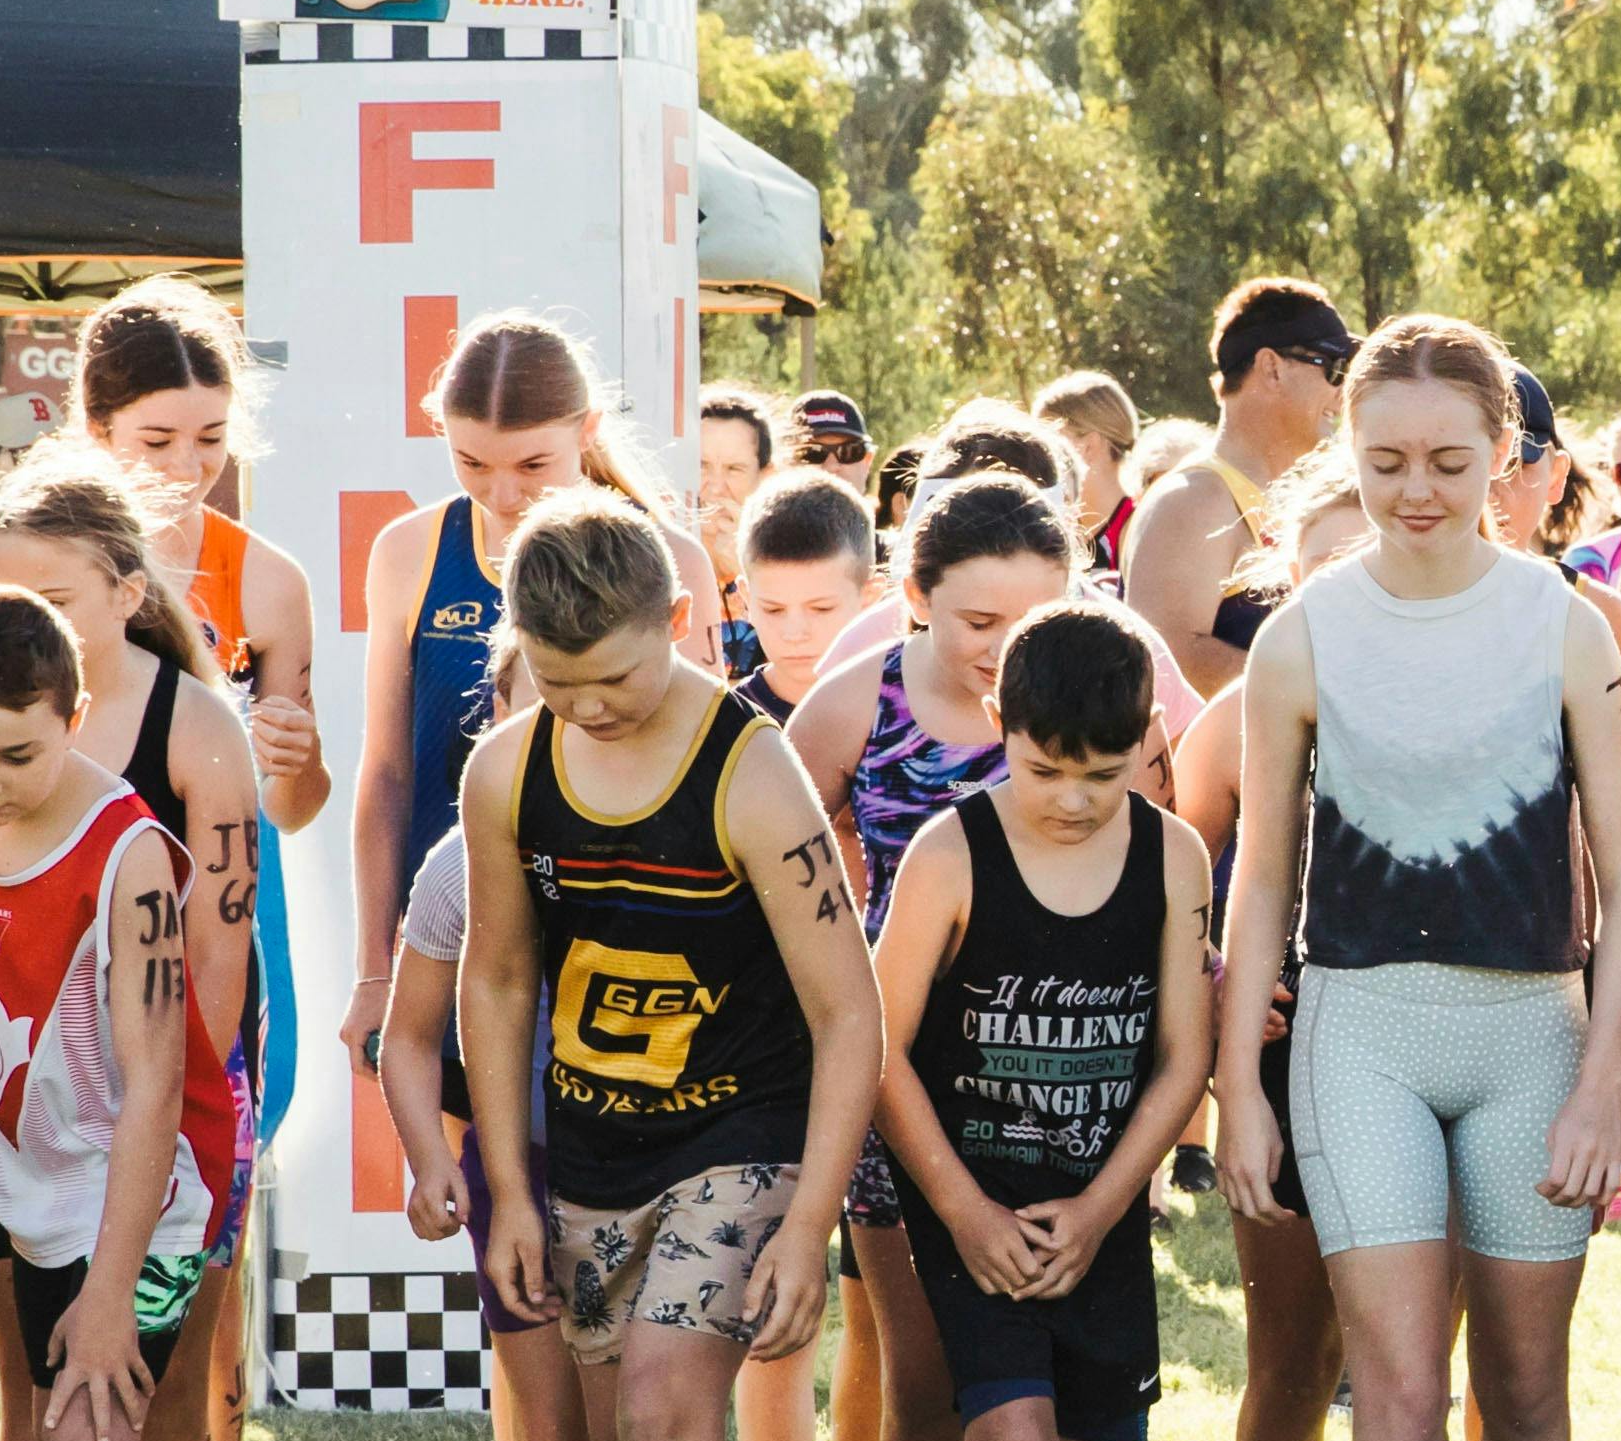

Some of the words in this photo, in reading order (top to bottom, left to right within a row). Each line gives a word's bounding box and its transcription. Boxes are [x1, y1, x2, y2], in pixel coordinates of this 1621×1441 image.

[29, 398, 51, 422] B
[947, 779, 993, 792] speedo
[532, 854, 553, 877] 20
[989, 973, 1021, 1009] If
[1030, 975, 1055, 1003] it
[1056, 974, 1145, 1008] doesn't
[962, 1006, 1152, 1049] CHALLENG
[989, 1053, 1029, 1073] YOU
[1034, 1056, 1056, 1074] IT
[1059, 1054, 1133, 1078] DOESN'T
[954, 1077, 1091, 1115] CHANGE
[1099, 1079, 1139, 1111] YO
[962, 1119, 994, 1141] 20
[960, 1140, 1044, 1166] GANMAIN
